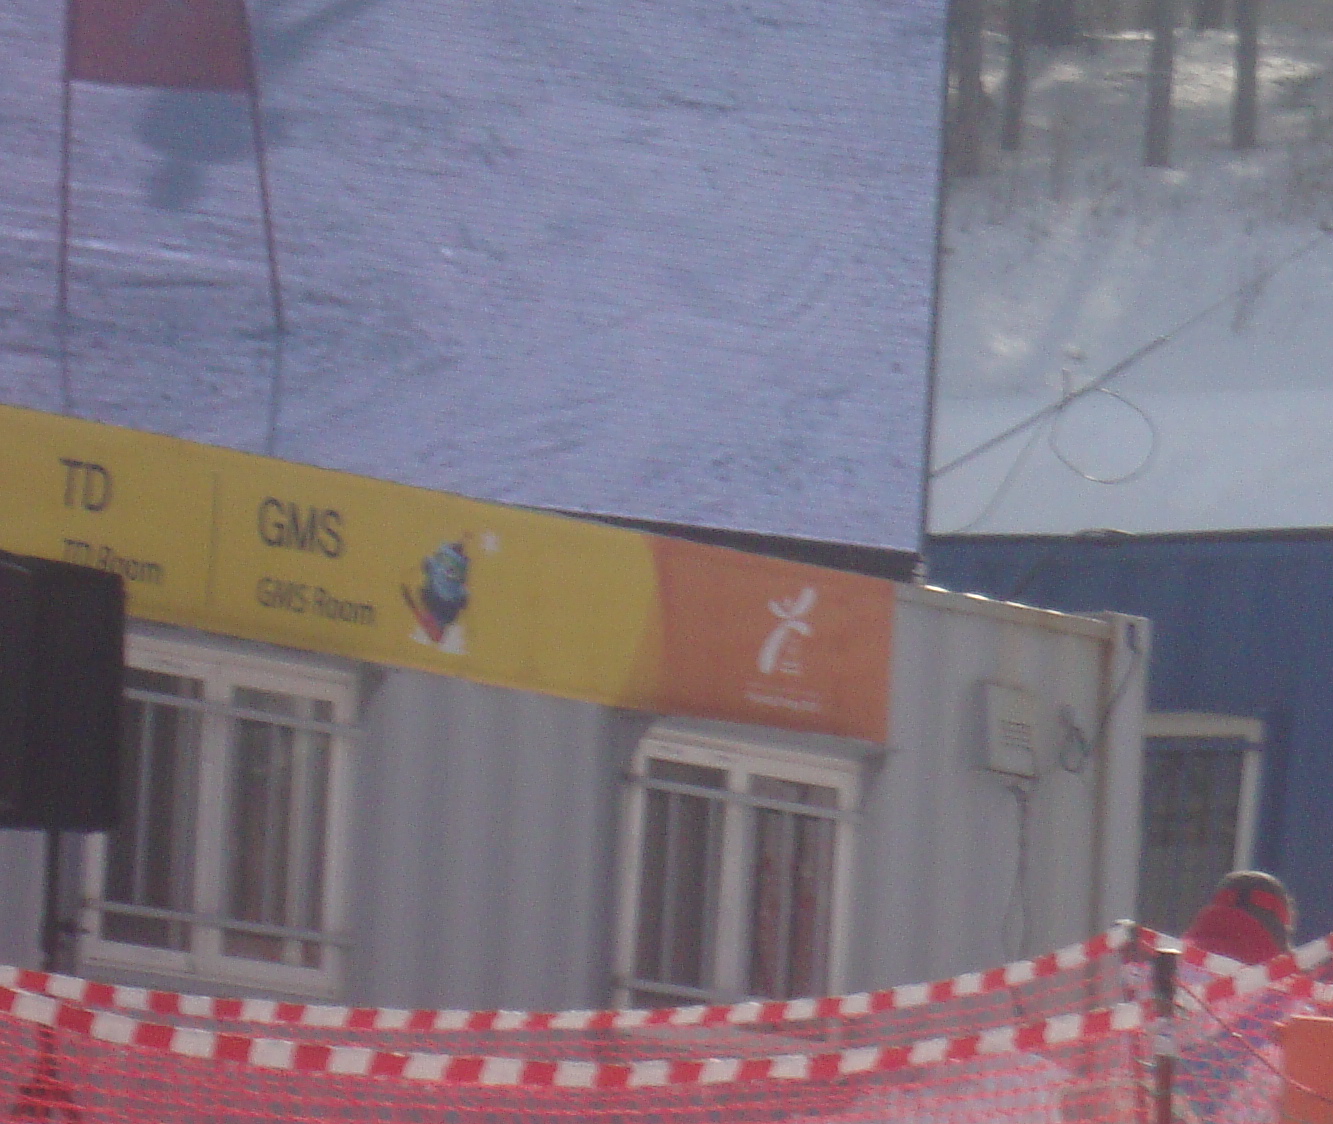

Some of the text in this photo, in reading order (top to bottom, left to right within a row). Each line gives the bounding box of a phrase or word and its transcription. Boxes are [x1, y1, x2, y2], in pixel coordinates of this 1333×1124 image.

[59, 458, 114, 512] TD
[257, 496, 346, 558] GMS
[255, 577, 376, 627] GMS Room
